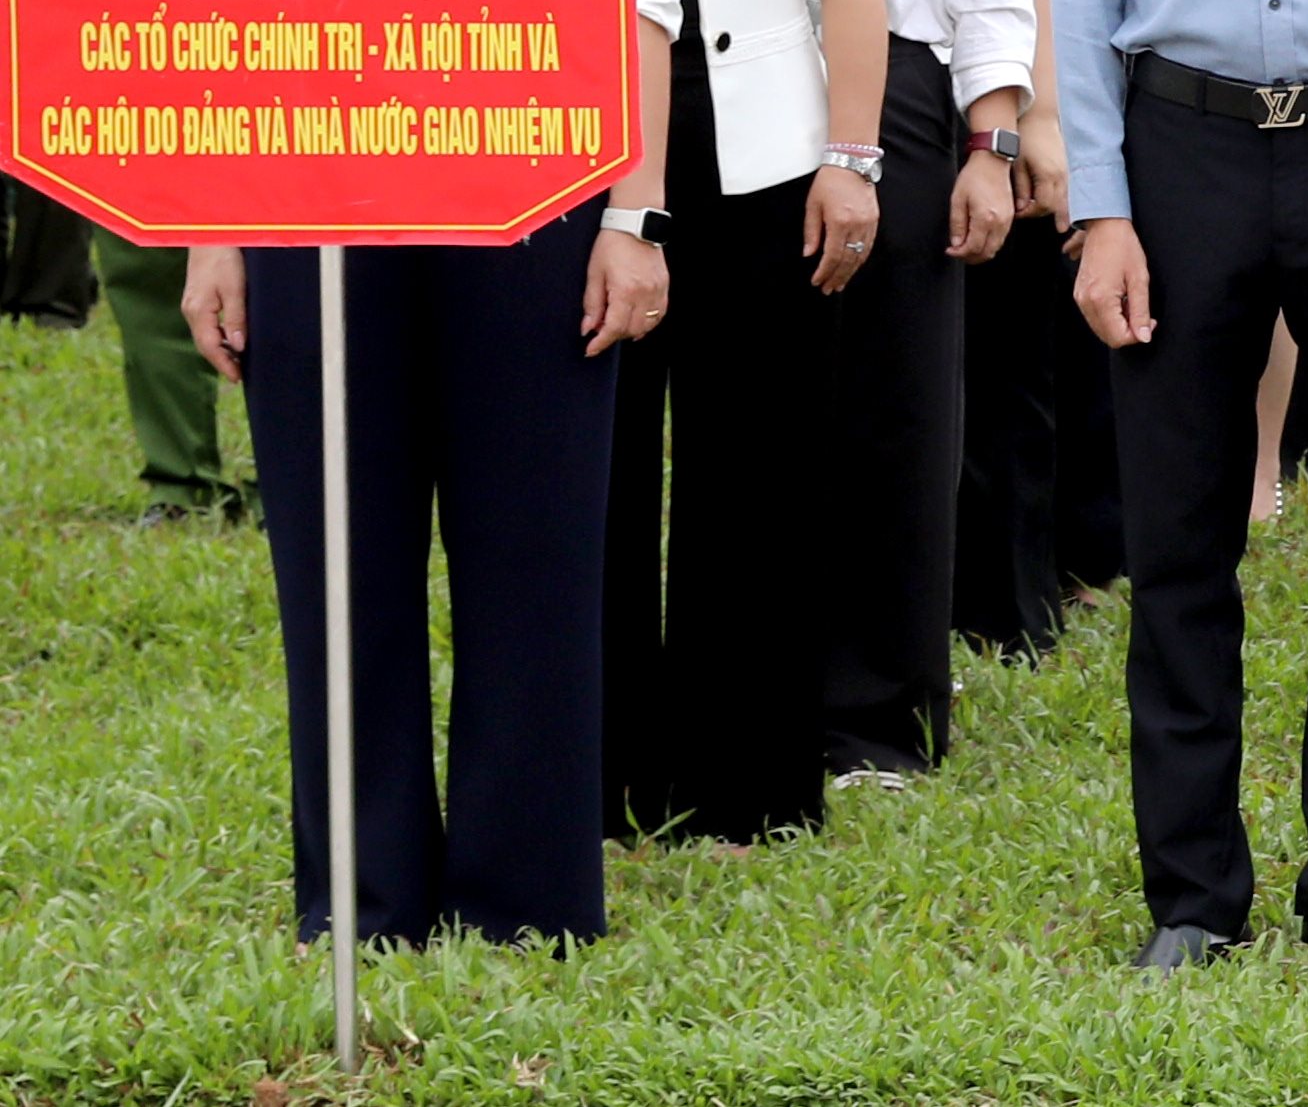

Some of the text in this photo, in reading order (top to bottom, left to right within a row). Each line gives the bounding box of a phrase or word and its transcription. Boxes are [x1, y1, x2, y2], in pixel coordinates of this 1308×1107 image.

[81, 12, 131, 71] CÁC
[136, 3, 167, 71] TỔ
[173, 12, 239, 71] CHỨC
[244, 12, 319, 71] CHÍNH
[324, 23, 362, 82] TRỊ
[384, 13, 417, 71] XÃ
[422, 13, 461, 82] HỘI
[467, 7, 523, 71] TỈNH
[527, 13, 560, 71] VÀ
[41, 90, 601, 167] CÁC HỘI DO ĐẢNG VÀ NHÀ NƯỚC GIAO NHIỆM VỤ
